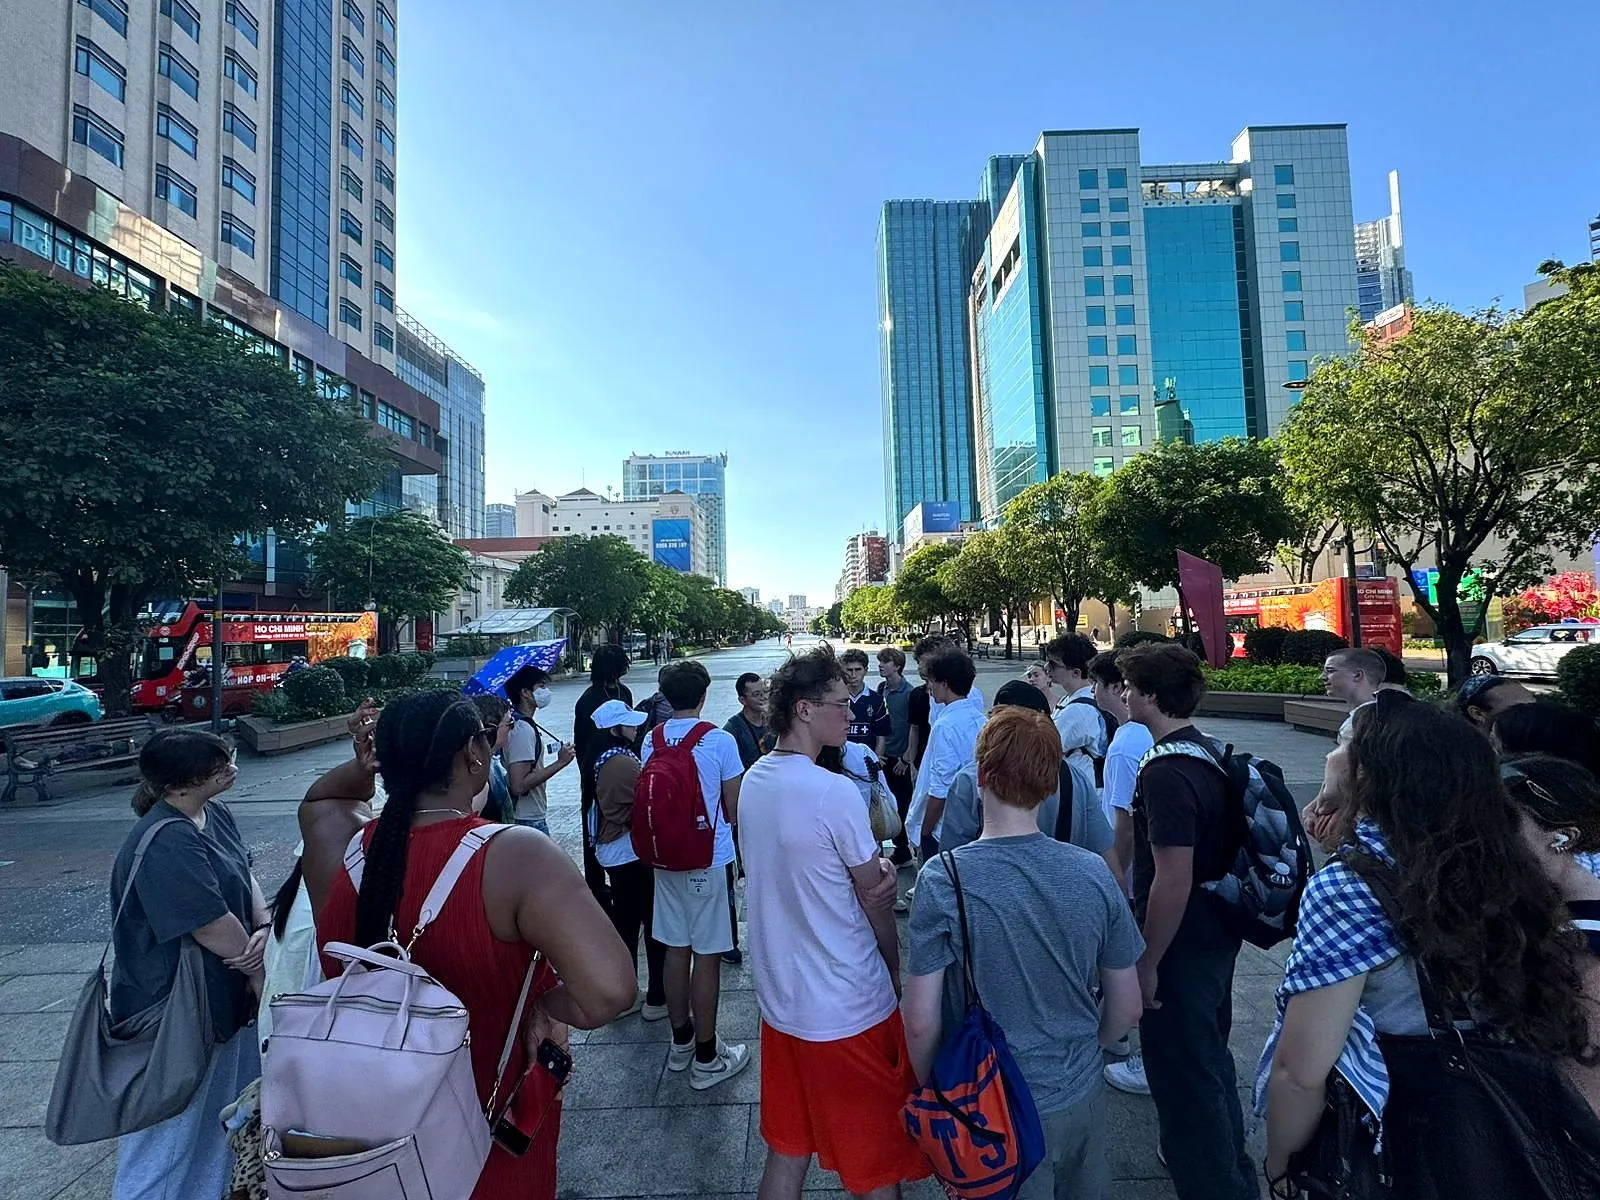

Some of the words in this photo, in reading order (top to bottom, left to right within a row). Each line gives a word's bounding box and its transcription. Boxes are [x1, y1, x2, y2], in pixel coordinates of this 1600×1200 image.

[254, 624, 267, 633] HO
[268, 624, 282, 633] CHI
[283, 624, 304, 633] MINH
[237, 675, 254, 685] HOP
